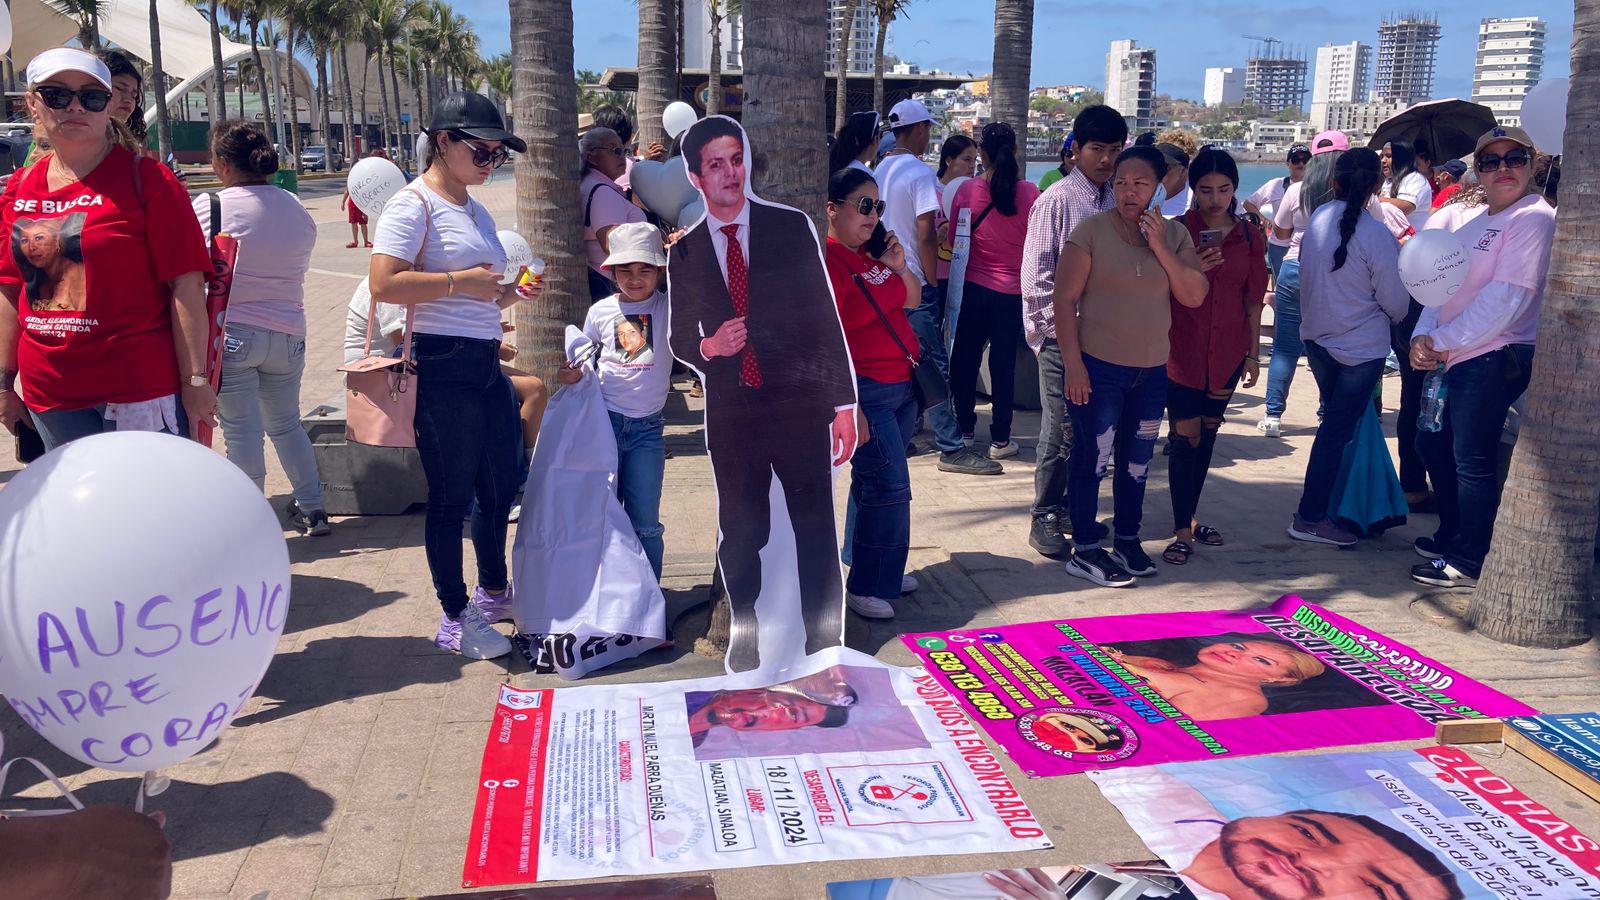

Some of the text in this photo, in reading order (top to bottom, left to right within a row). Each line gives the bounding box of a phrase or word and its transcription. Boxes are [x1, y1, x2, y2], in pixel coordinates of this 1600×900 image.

[13, 194, 103, 214] SE BUSCA
[54, 323, 91, 333] GAMBOA
[927, 650, 1016, 721] 638 113 4868
[1291, 605, 1381, 663] BUSCANDOTE
[1372, 663, 1408, 682] LUIS
[1406, 682, 1457, 705] ALAN
[1068, 654, 1135, 699] NOVIEMBRE
[1124, 698, 1167, 724] 2024
[1080, 643, 1141, 685] ALEJANDRINA
[1133, 685, 1184, 718] BECERRA
[1175, 719, 1231, 755] GAMBOA
[944, 728, 976, 737] A
[1017, 716, 1073, 758] 638 113 48 68
[645, 755, 659, 783] PARRA
[746, 788, 765, 813] LUGAR:
[902, 774, 937, 809] TESOROS PERDIDOS
[953, 738, 1045, 840] ENCONTRARLO
[648, 784, 666, 821] DUEÑAS
[708, 763, 737, 846] MAZATLAN, SINALOA
[1375, 774, 1411, 801] Visto
[1404, 801, 1439, 822] por
[1436, 822, 1489, 861] última
[1518, 885, 1543, 897] el
[1427, 754, 1600, 852] ¿LO HAS
[1447, 789, 1508, 829] Alexis
[1401, 813, 1522, 900] enero del 202
[1464, 821, 1559, 887] Bastidas
